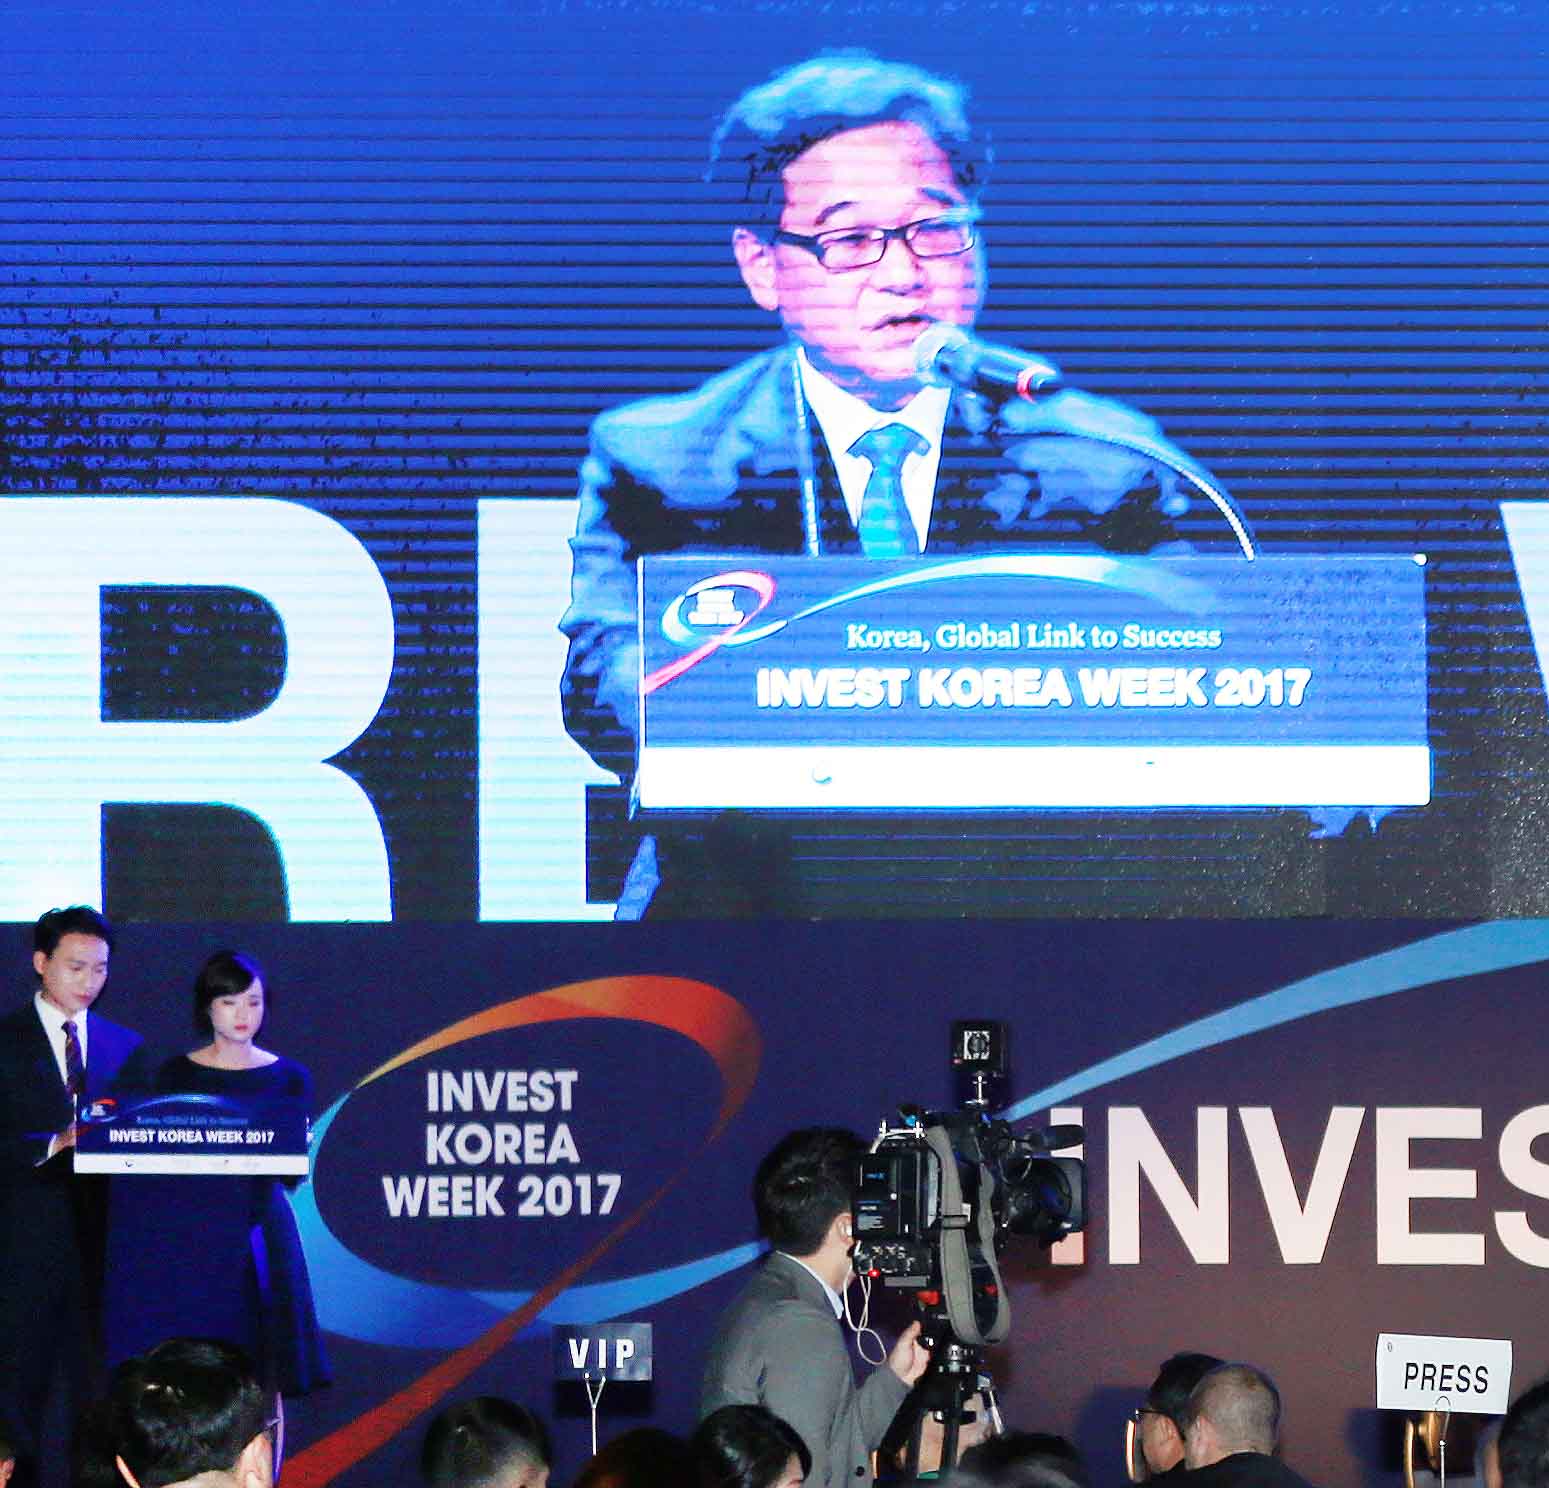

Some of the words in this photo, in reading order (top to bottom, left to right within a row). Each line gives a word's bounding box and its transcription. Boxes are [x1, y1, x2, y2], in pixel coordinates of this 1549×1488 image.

[846, 623, 931, 653] Korea,
[936, 623, 1022, 650] Global
[1026, 623, 1086, 650] Link
[1091, 625, 1117, 650] to
[1123, 623, 1223, 650] Success
[756, 667, 912, 709] INVEST
[918, 667, 1073, 709] KOREA
[1077, 667, 1209, 709] WEEK
[1213, 667, 1313, 709] 2017
[426, 1070, 579, 1113] INVEST
[109, 1129, 156, 1143] INVEST
[158, 1129, 204, 1144] KOREA
[206, 1129, 244, 1144] WEEK
[245, 1130, 275, 1144] 2017
[425, 1123, 581, 1166] KOREA
[381, 1175, 506, 1218] WEEK
[516, 1174, 622, 1217] 2017
[568, 1338, 635, 1369] VIP
[1404, 1362, 1489, 1394] PRESS
